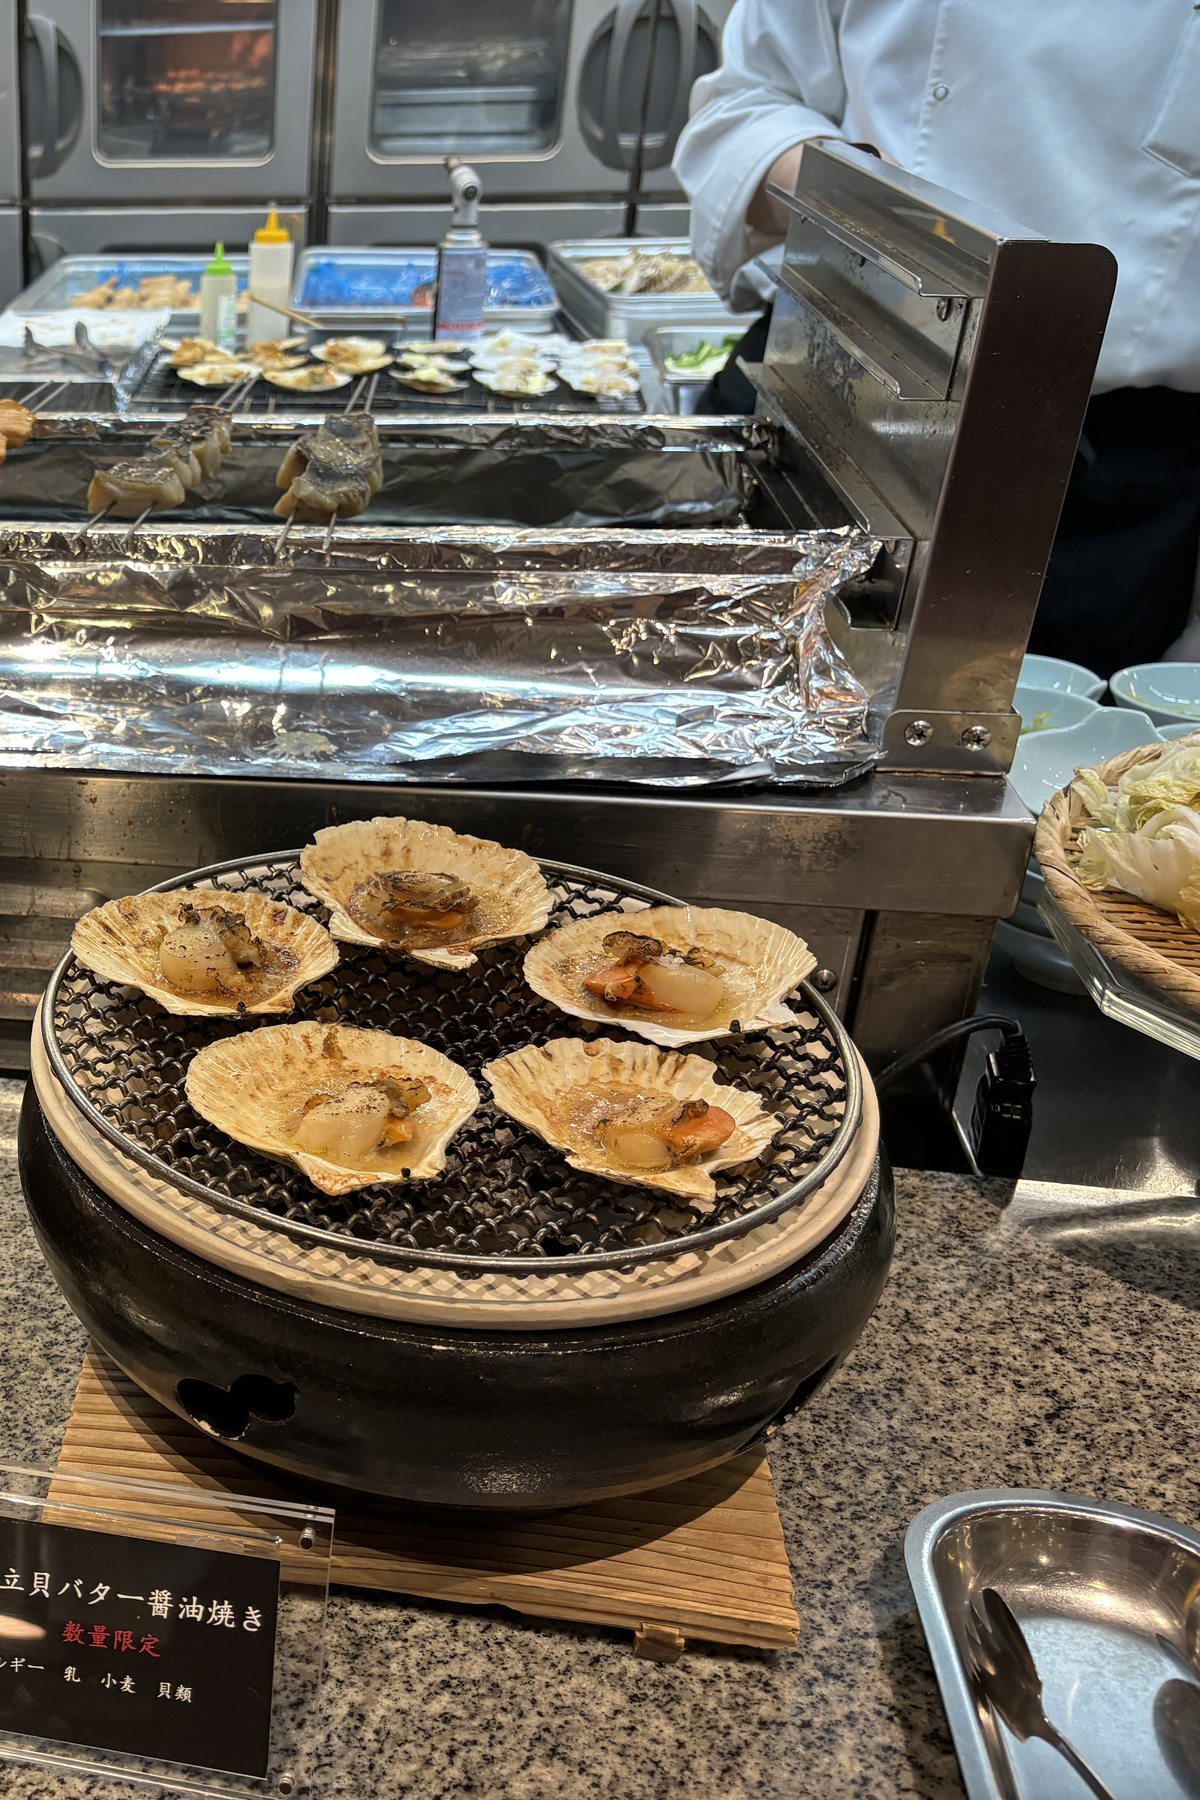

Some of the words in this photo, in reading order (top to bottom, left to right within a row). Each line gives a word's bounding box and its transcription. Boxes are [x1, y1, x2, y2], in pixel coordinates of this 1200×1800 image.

[61, 1620, 161, 1658] 数量限定
[63, 1665, 81, 1684] 乳
[100, 1672, 136, 1694] 小麦
[156, 1681, 193, 1704] 貝類
